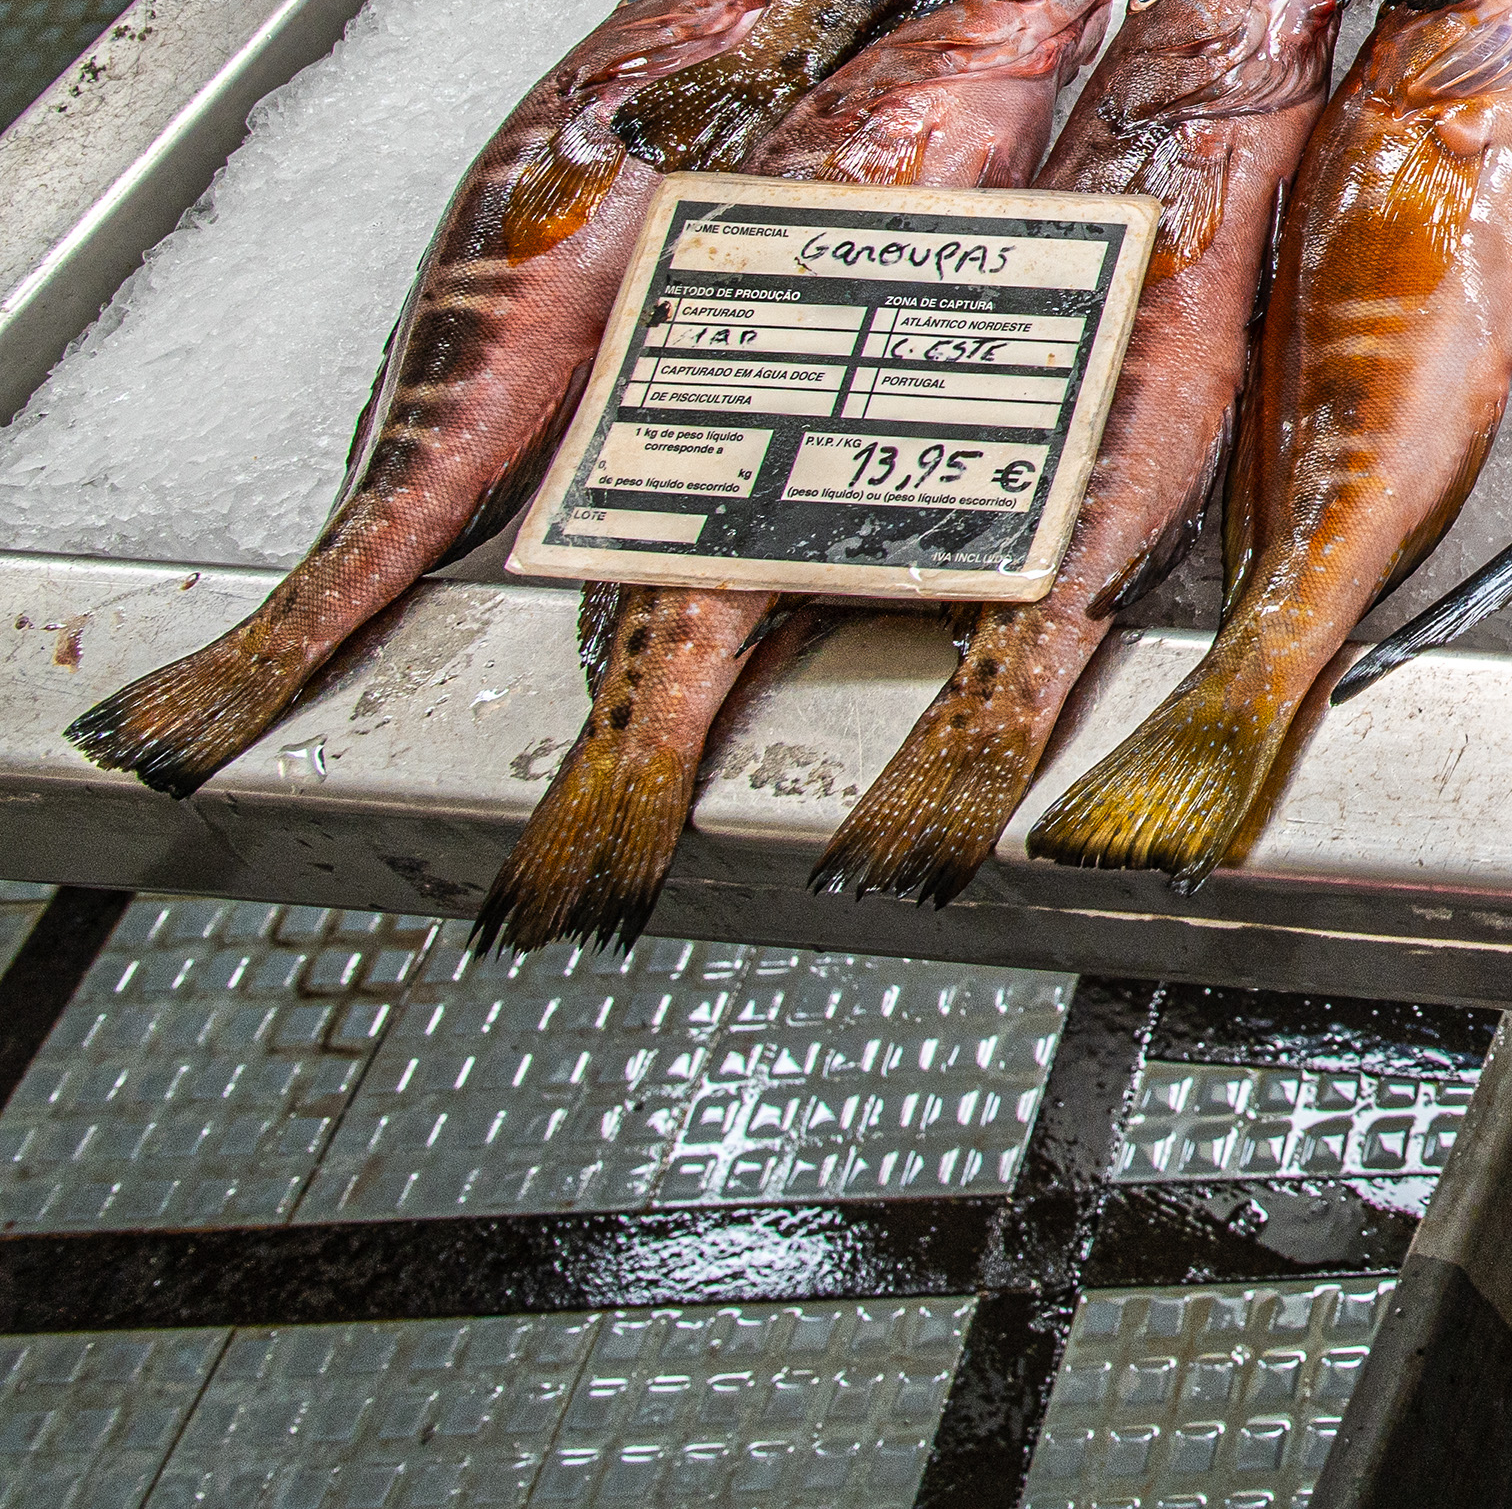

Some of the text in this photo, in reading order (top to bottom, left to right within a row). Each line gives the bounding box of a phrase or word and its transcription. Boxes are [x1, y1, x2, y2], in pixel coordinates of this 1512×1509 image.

[722, 225, 789, 237] COMERCIAL
[665, 285, 801, 302] MÉTODO DE PRODUÇÃO
[885, 296, 994, 311] ZONA DE CAPTURA
[682, 306, 755, 319] CAPTURADO
[900, 316, 1033, 332] ATLÂNTICO NORDESTE
[661, 365, 825, 382] CAPTURADO EM ÁGUA DOCE
[881, 376, 946, 389] PORTUGAL
[650, 392, 752, 405] DE PISCICULTURA
[636, 428, 744, 443] 1 kg de peso líquido
[644, 442, 714, 455] corresponde
[844, 439, 862, 449] KG
[848, 441, 1036, 493] 13,95 €
[738, 468, 752, 480] kg
[599, 475, 740, 493] de peso líquido escorrido
[787, 486, 1017, 509] (peso líquido) ou (peso líquido escorrido)
[573, 510, 607, 521] LOTE
[932, 551, 951, 562] IVA
